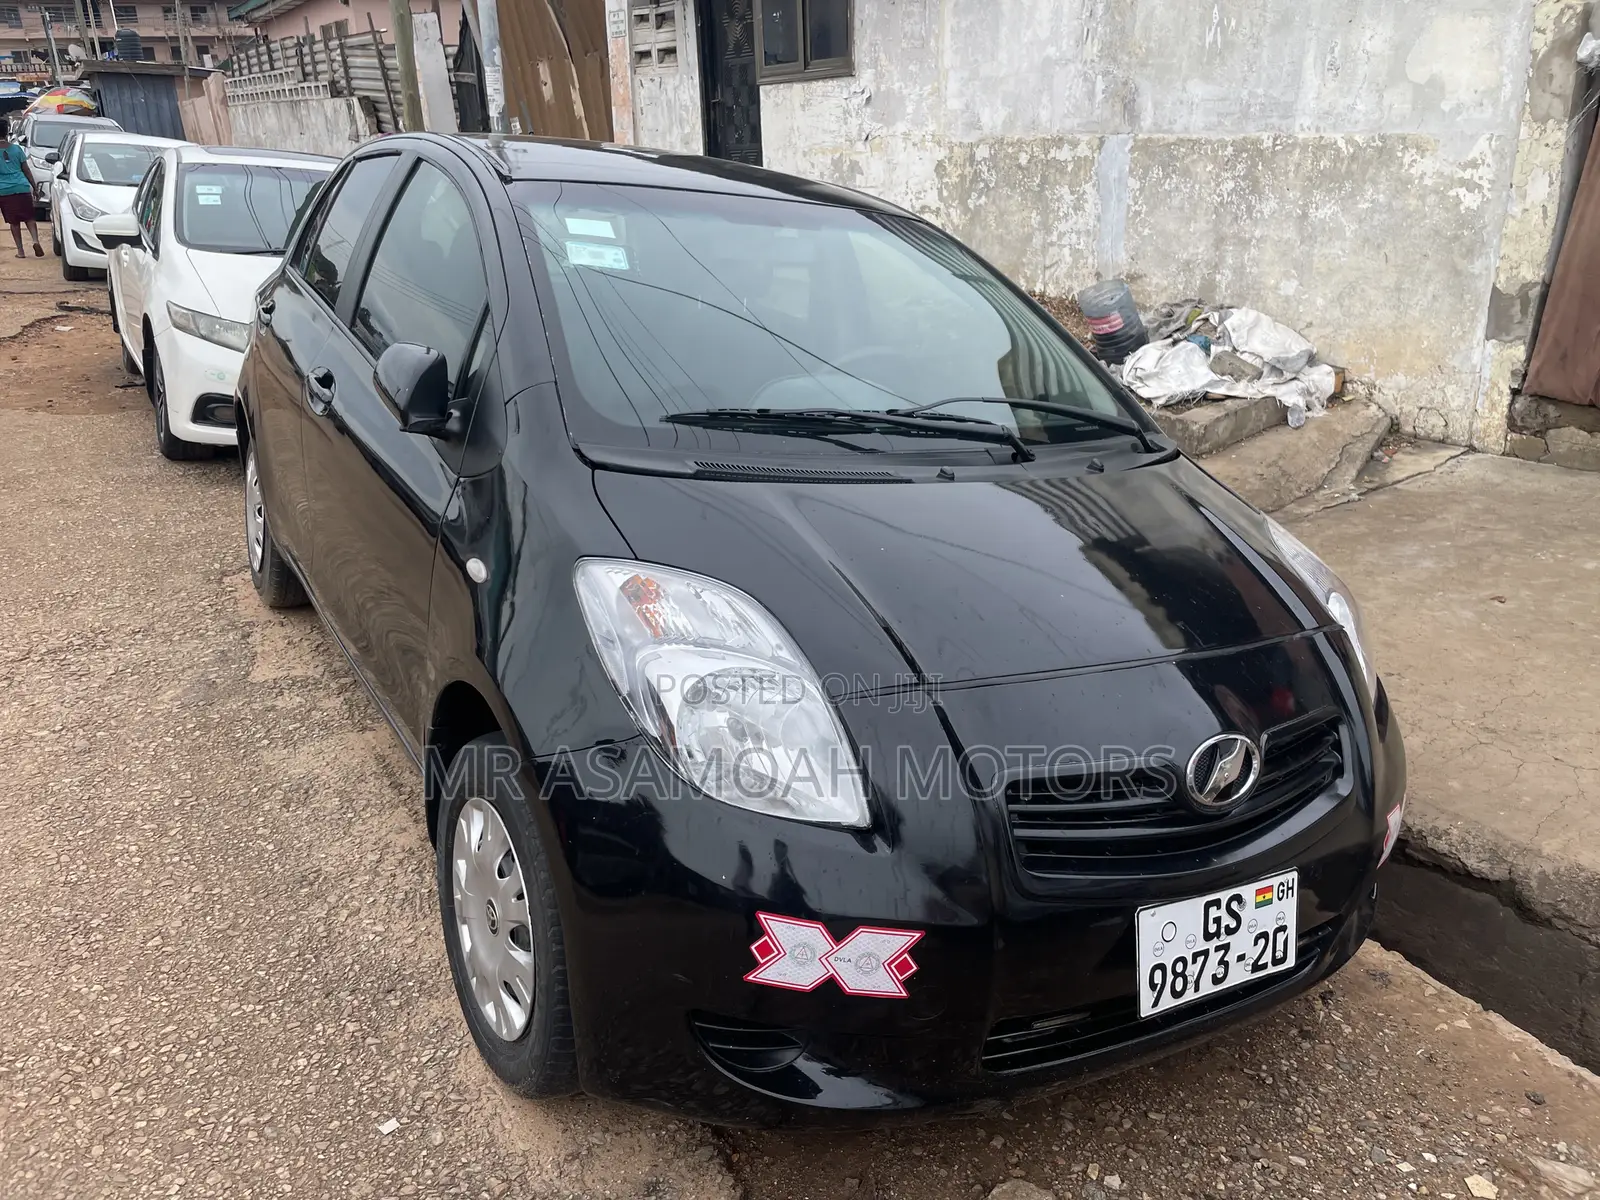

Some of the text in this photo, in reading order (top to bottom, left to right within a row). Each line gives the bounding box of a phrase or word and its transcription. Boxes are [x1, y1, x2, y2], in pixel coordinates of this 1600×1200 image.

[1276, 877, 1295, 902] GH
[1202, 893, 1244, 942] GS
[833, 956, 852, 964] DVLA
[1149, 924, 1289, 1009] 9873-20
